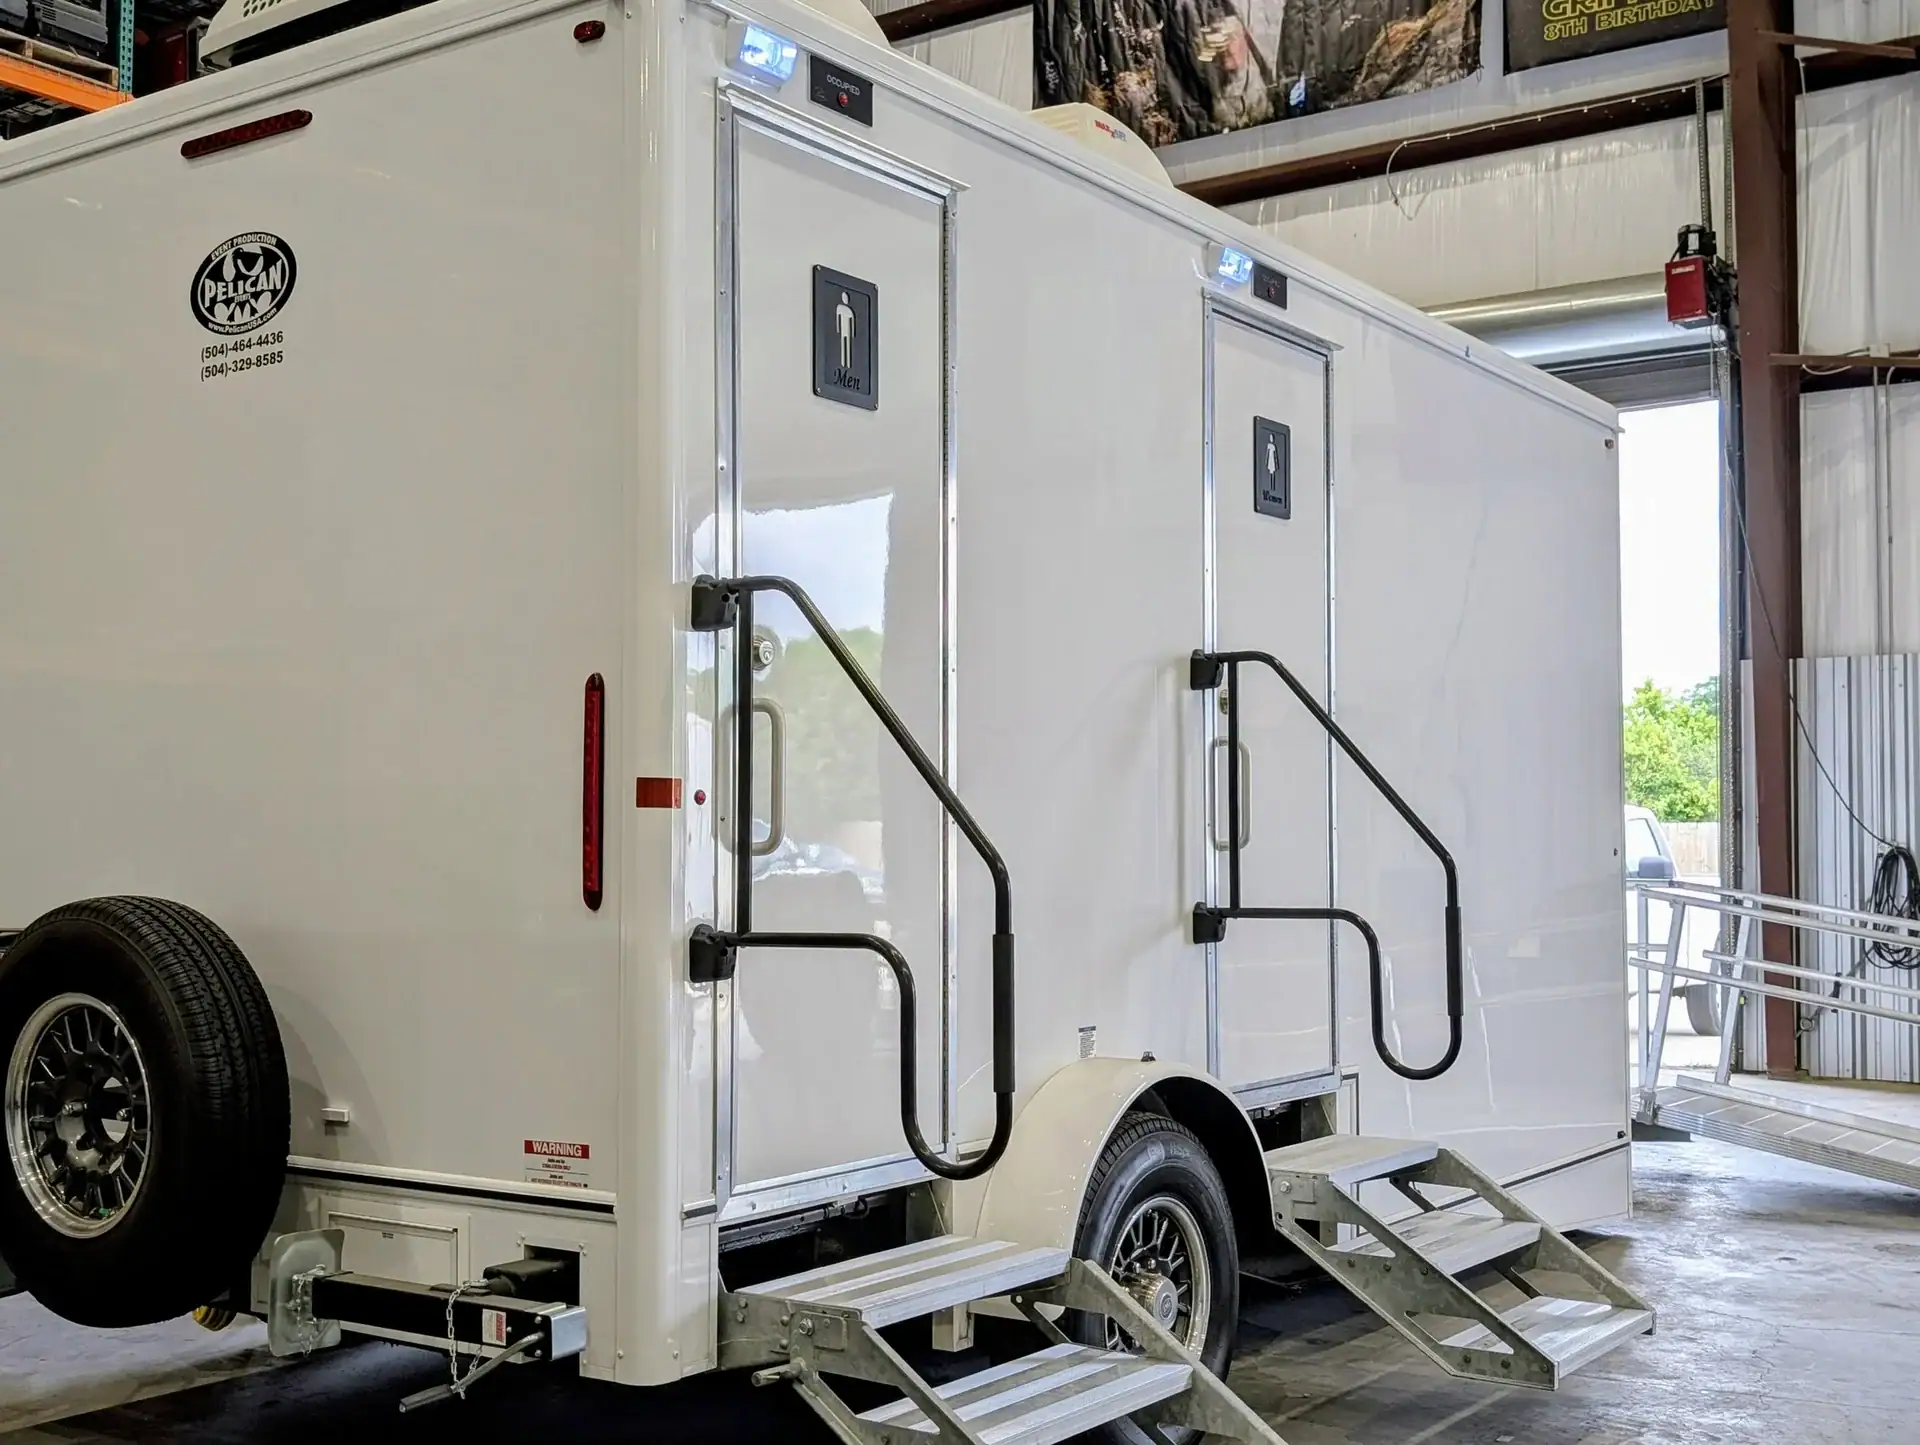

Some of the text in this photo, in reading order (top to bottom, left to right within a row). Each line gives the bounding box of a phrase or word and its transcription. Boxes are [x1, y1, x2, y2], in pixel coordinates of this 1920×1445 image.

[1542, 0, 1641, 20] GR
[1543, 16, 1588, 41] 8TH
[826, 74, 861, 96] OCCUPIED
[210, 233, 277, 261] EVENT PRODUCTION
[204, 259, 282, 309] PELICAN
[207, 308, 277, 333] www.PelicanUSA.com
[201, 330, 284, 363] (504)-464-4436
[200, 350, 284, 382] (504)-329-8585
[833, 367, 861, 391] Men
[532, 1140, 582, 1157] WARNING
